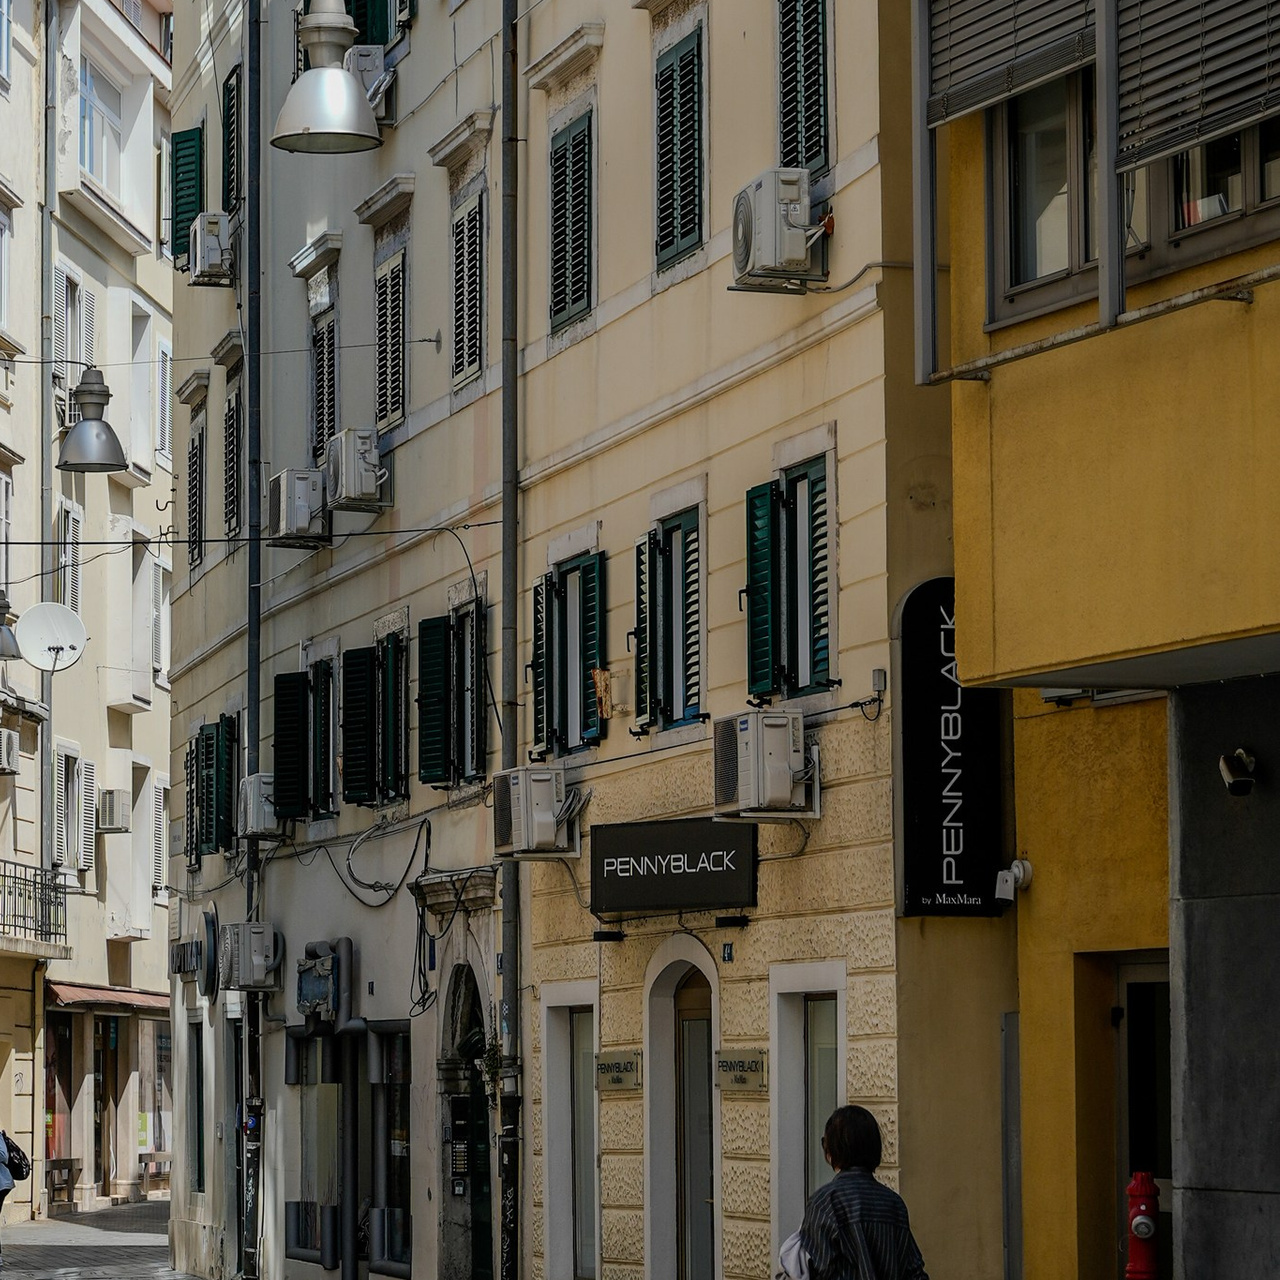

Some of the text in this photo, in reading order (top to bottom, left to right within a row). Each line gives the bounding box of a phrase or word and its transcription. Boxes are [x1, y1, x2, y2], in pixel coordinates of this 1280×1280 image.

[940, 605, 964, 885] PENNYBLACK
[603, 850, 736, 878] PENNYBLACK
[935, 893, 981, 905] MaxMara
